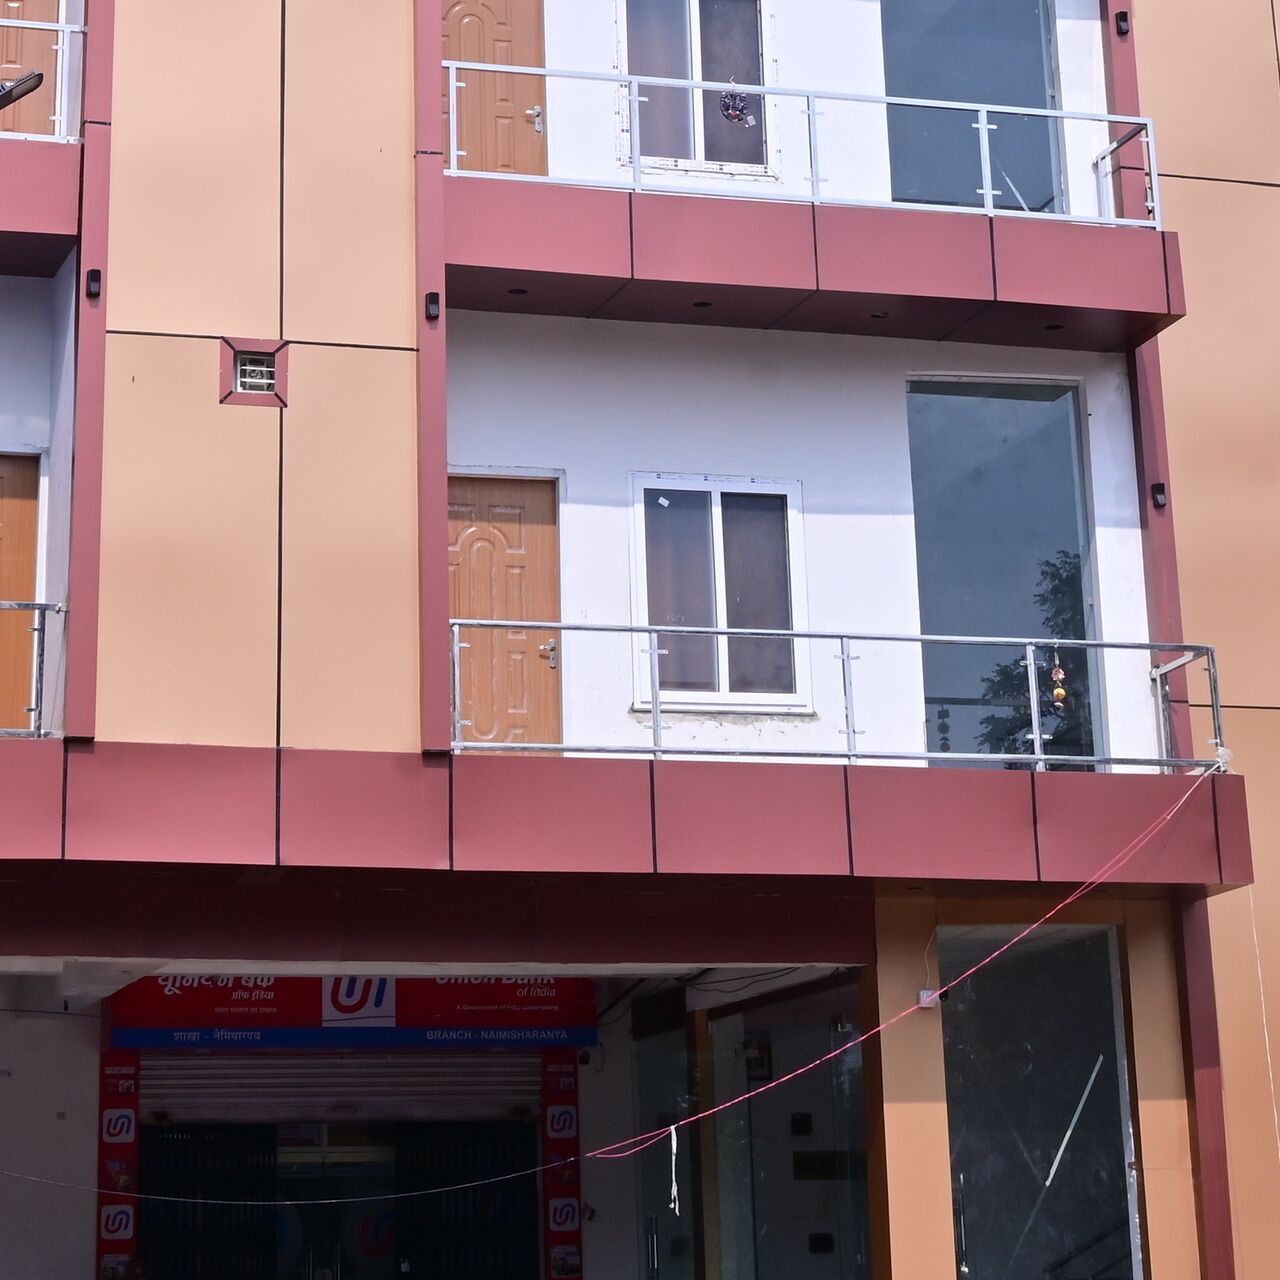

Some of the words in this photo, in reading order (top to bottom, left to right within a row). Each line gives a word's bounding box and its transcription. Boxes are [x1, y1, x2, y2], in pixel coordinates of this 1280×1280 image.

[516, 986, 529, 997] of
[530, 986, 556, 997] India
[426, 1030, 472, 1040] BRANCH
[480, 1029, 568, 1040] NAIMISHARANYA
